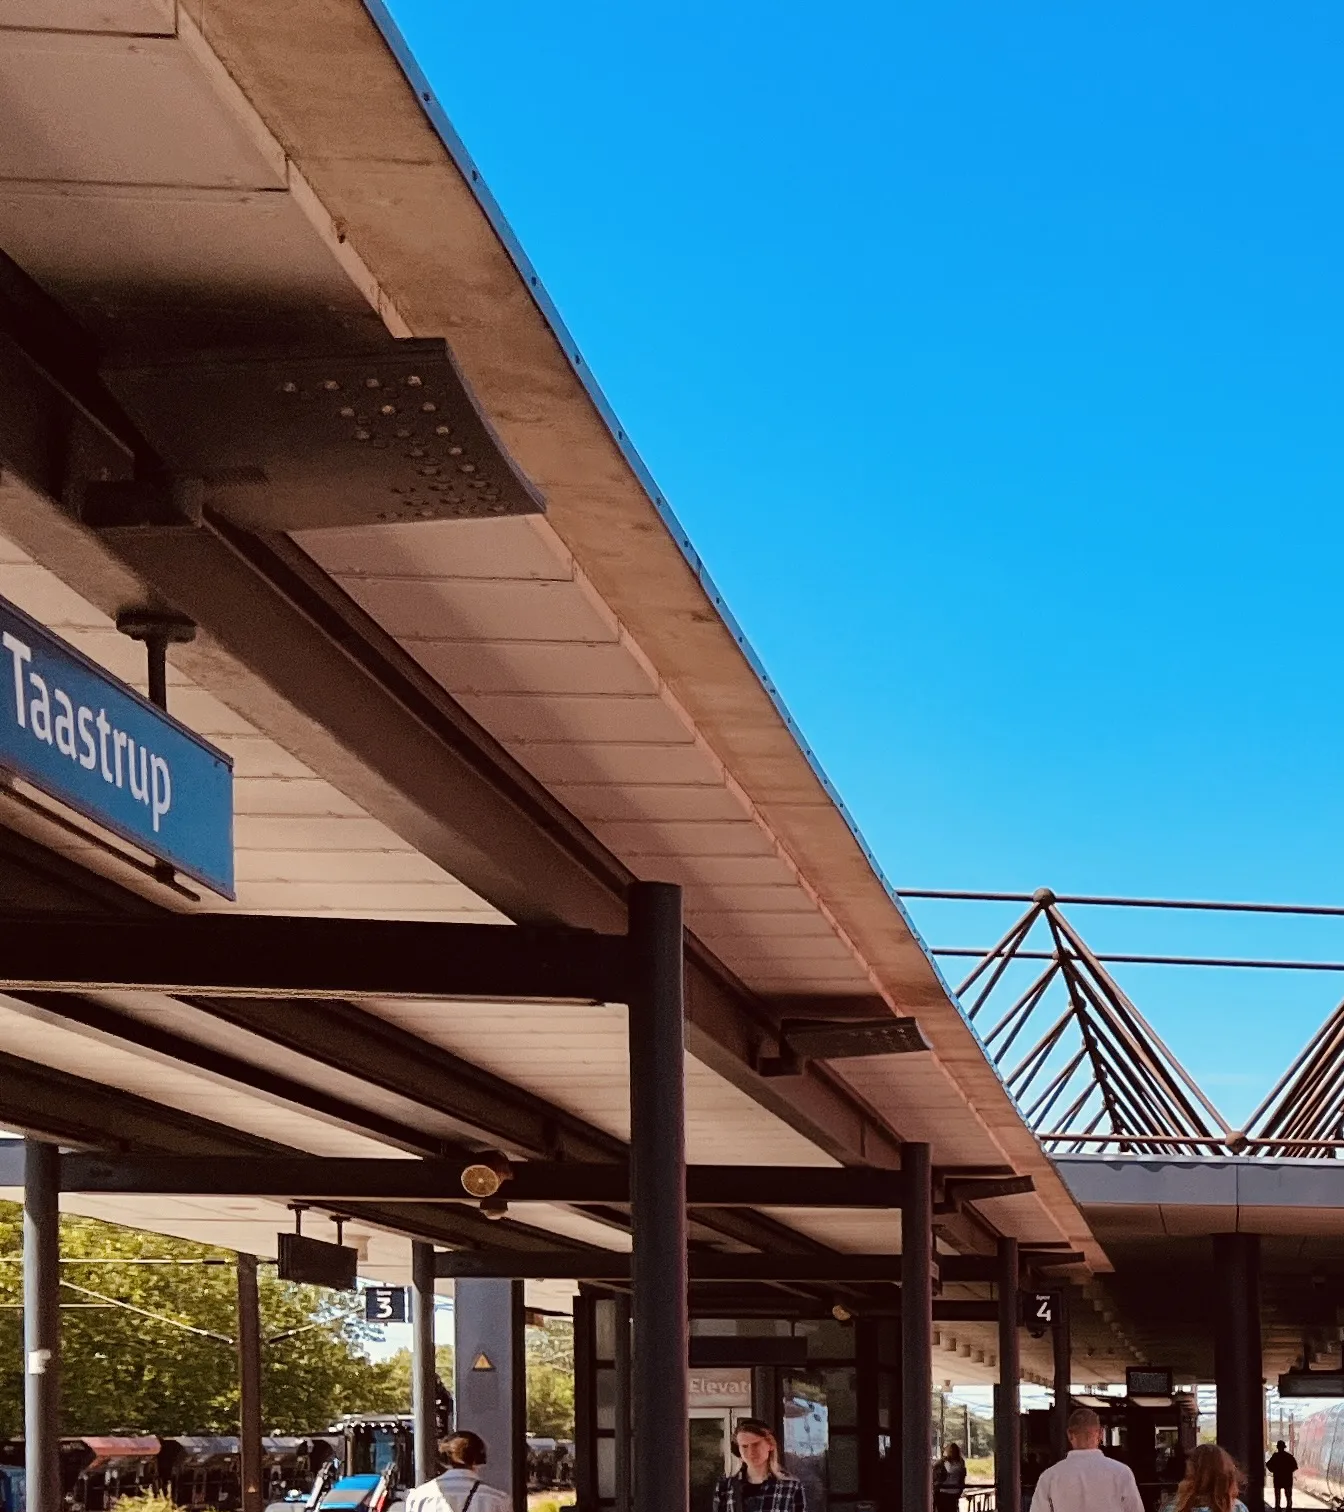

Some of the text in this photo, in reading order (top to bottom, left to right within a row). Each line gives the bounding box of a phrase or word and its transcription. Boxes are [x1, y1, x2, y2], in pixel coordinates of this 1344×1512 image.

[2, 631, 173, 833] Taastrup
[376, 1296, 393, 1319] 3
[1036, 1301, 1052, 1322] 4
[688, 1378, 752, 1394] Elevat
